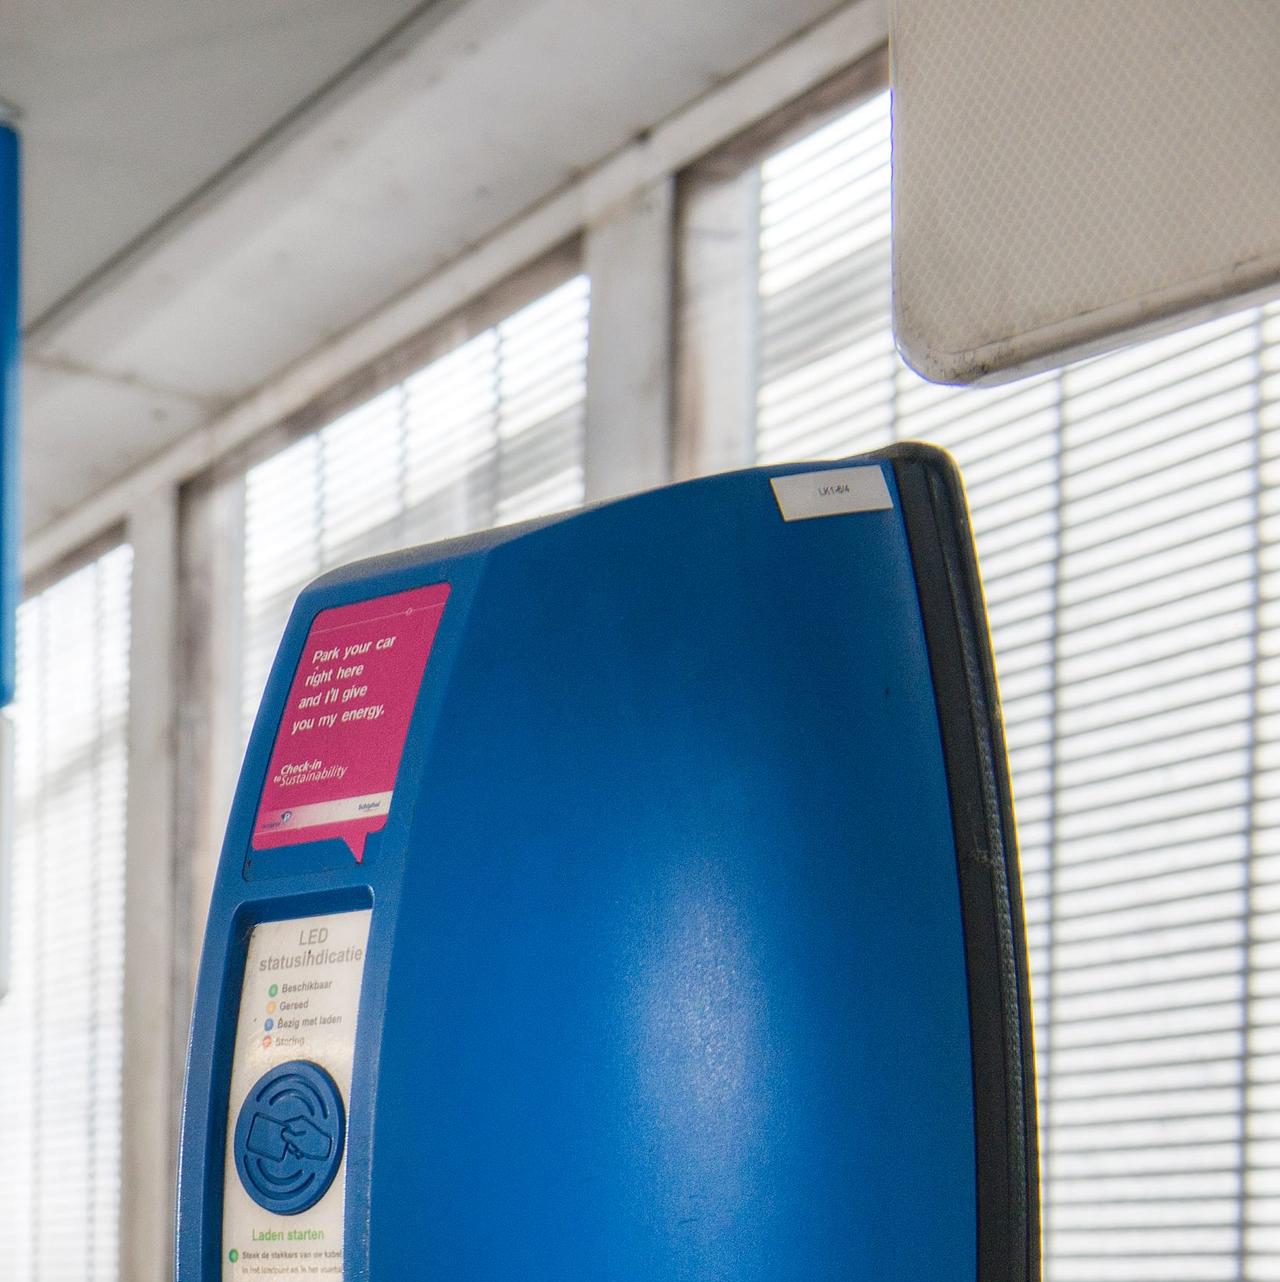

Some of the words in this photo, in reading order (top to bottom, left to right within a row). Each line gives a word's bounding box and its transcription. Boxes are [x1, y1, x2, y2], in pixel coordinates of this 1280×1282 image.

[312, 647, 340, 664] Park
[343, 641, 373, 660] your
[376, 636, 397, 650] car
[305, 665, 333, 687] right
[337, 664, 365, 680] here
[298, 691, 322, 709] and
[324, 687, 340, 705] I'll
[342, 684, 368, 703] give
[291, 718, 315, 735] you
[318, 713, 338, 728] my
[279, 764, 348, 788] Sustainability
[280, 758, 322, 776] Check-in
[299, 927, 329, 946] LED
[258, 947, 363, 972] statusindicatie
[281, 980, 333, 994] Beschikbaar
[279, 1000, 309, 1011] Gereed
[277, 1017, 300, 1030] Bezig
[302, 1017, 318, 1027] met
[319, 1014, 342, 1025] laden
[252, 1228, 284, 1241] Laden
[287, 1229, 324, 1241] starten
